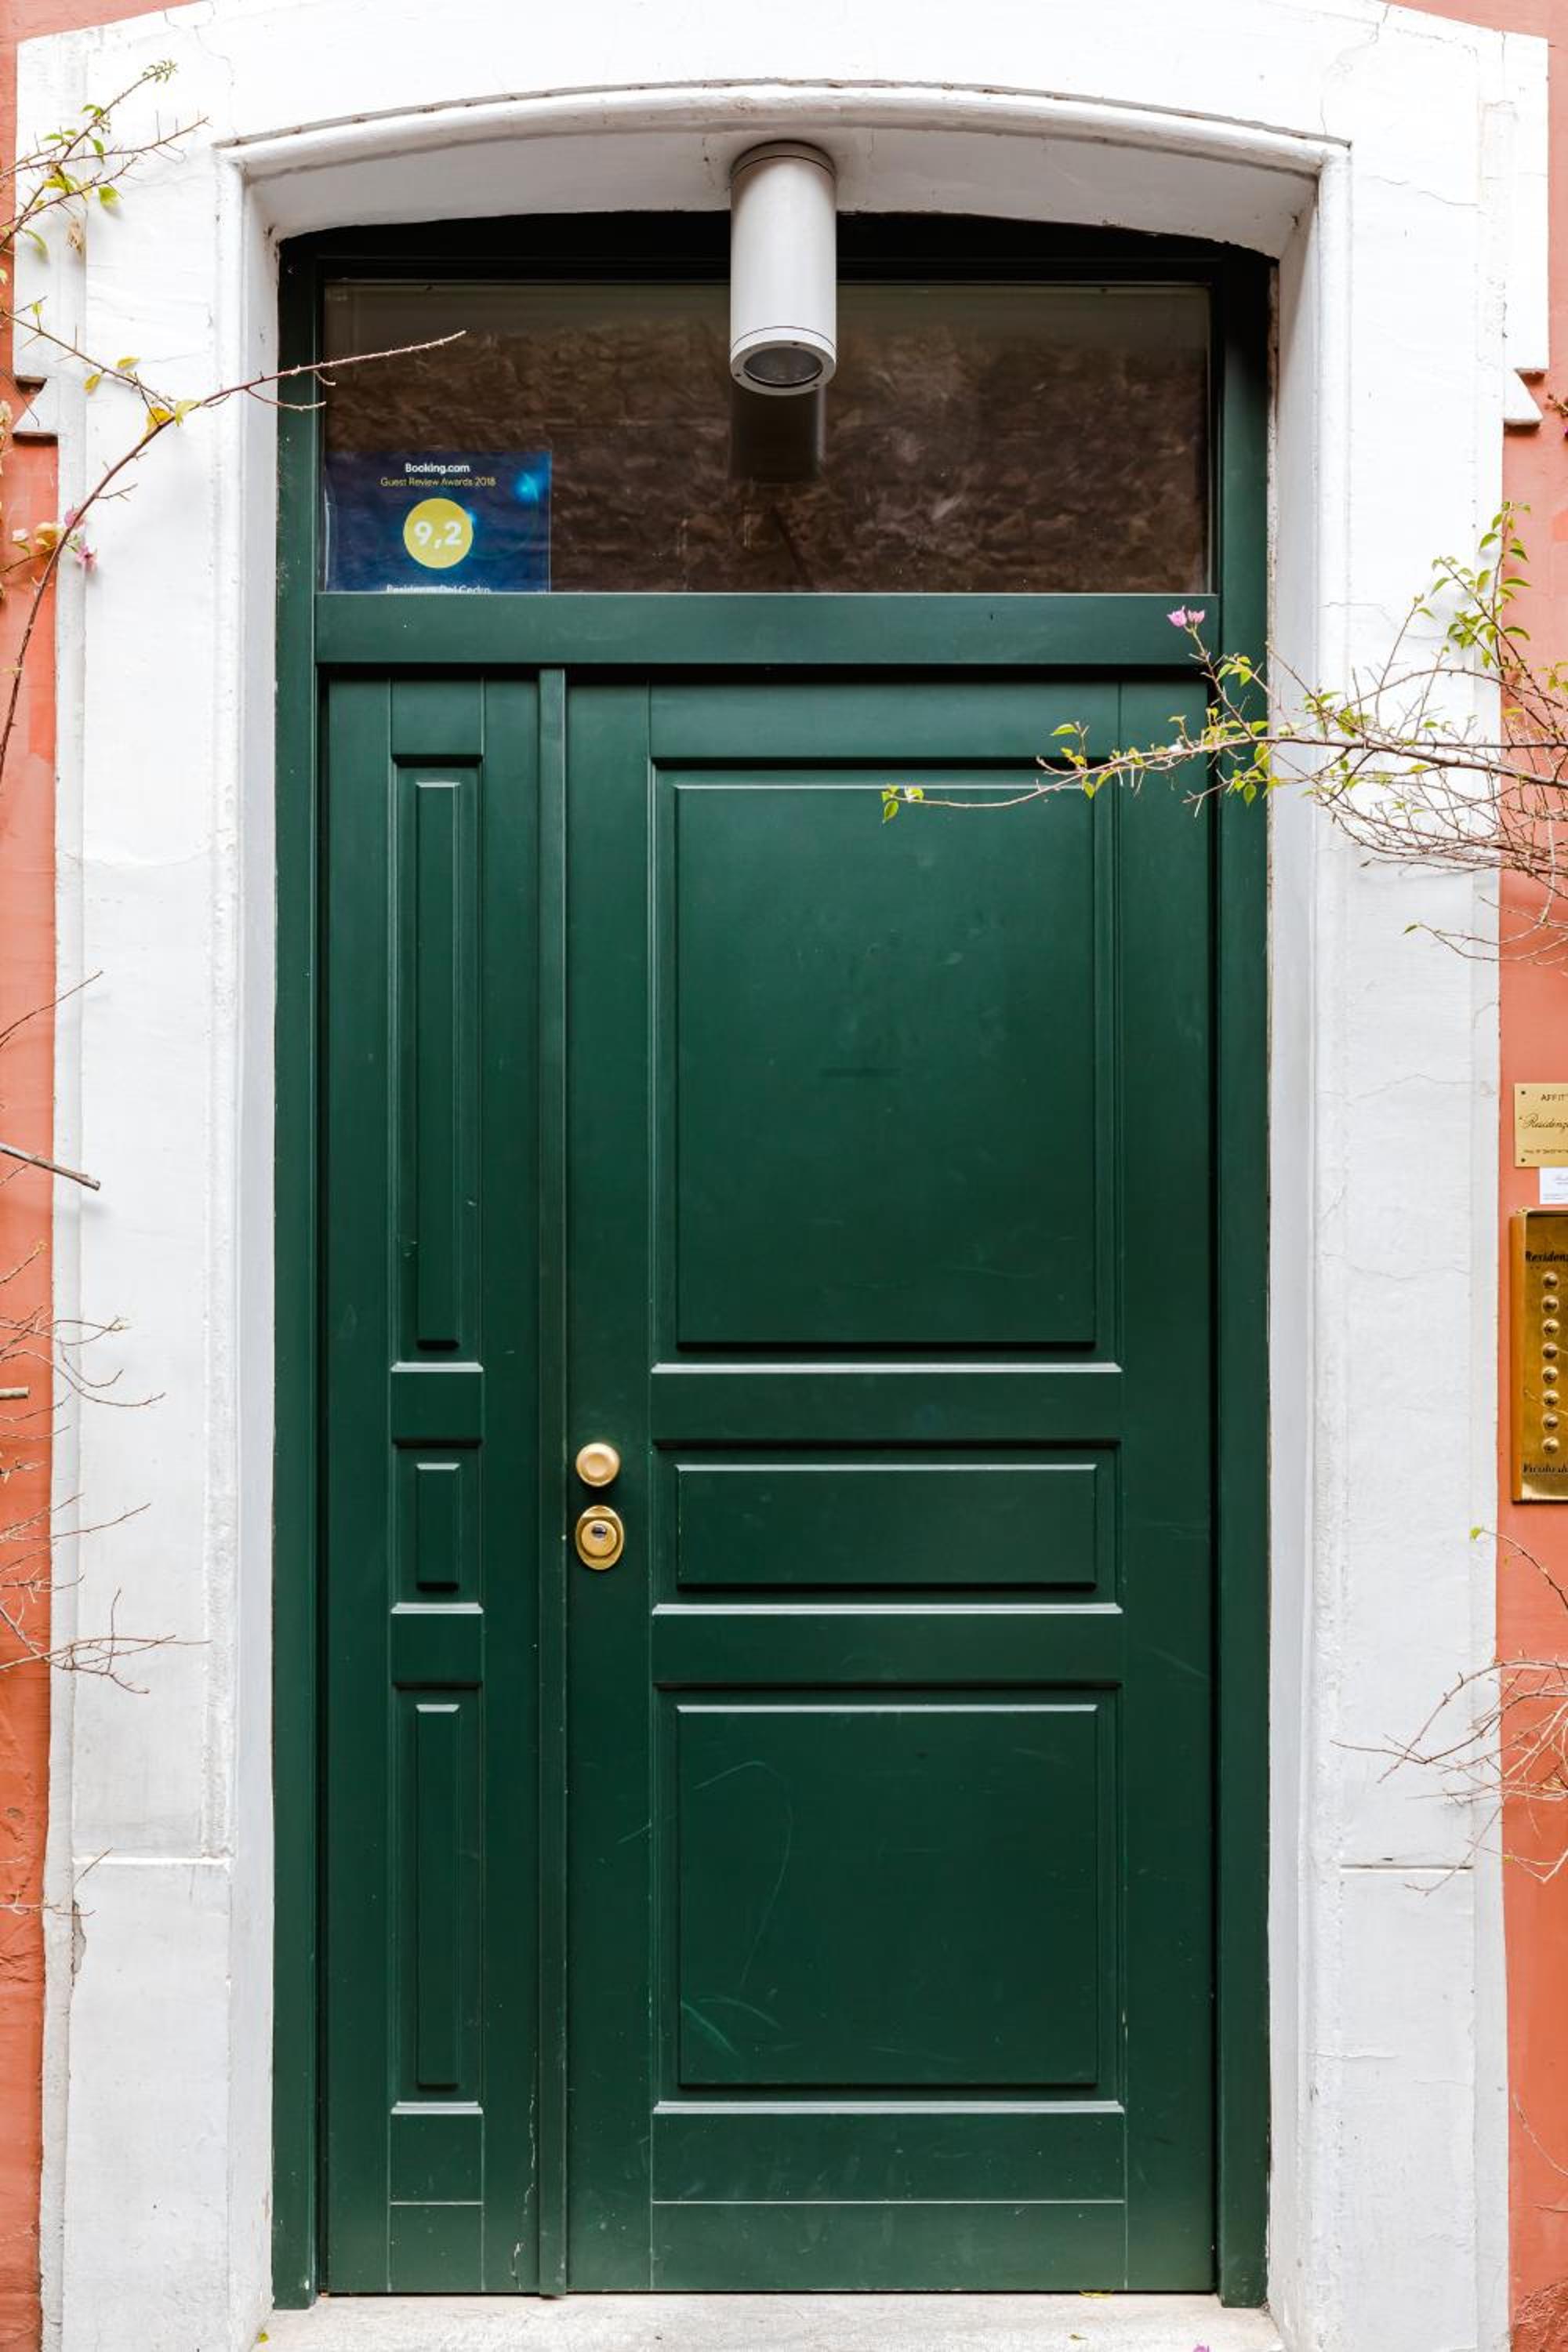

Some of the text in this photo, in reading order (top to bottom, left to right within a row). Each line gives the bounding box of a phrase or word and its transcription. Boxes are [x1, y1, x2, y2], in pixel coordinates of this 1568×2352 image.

[405, 462, 470, 474] Booking.com
[380, 476, 496, 486] Guest Review Awards 2018
[414, 521, 462, 550] 9,2
